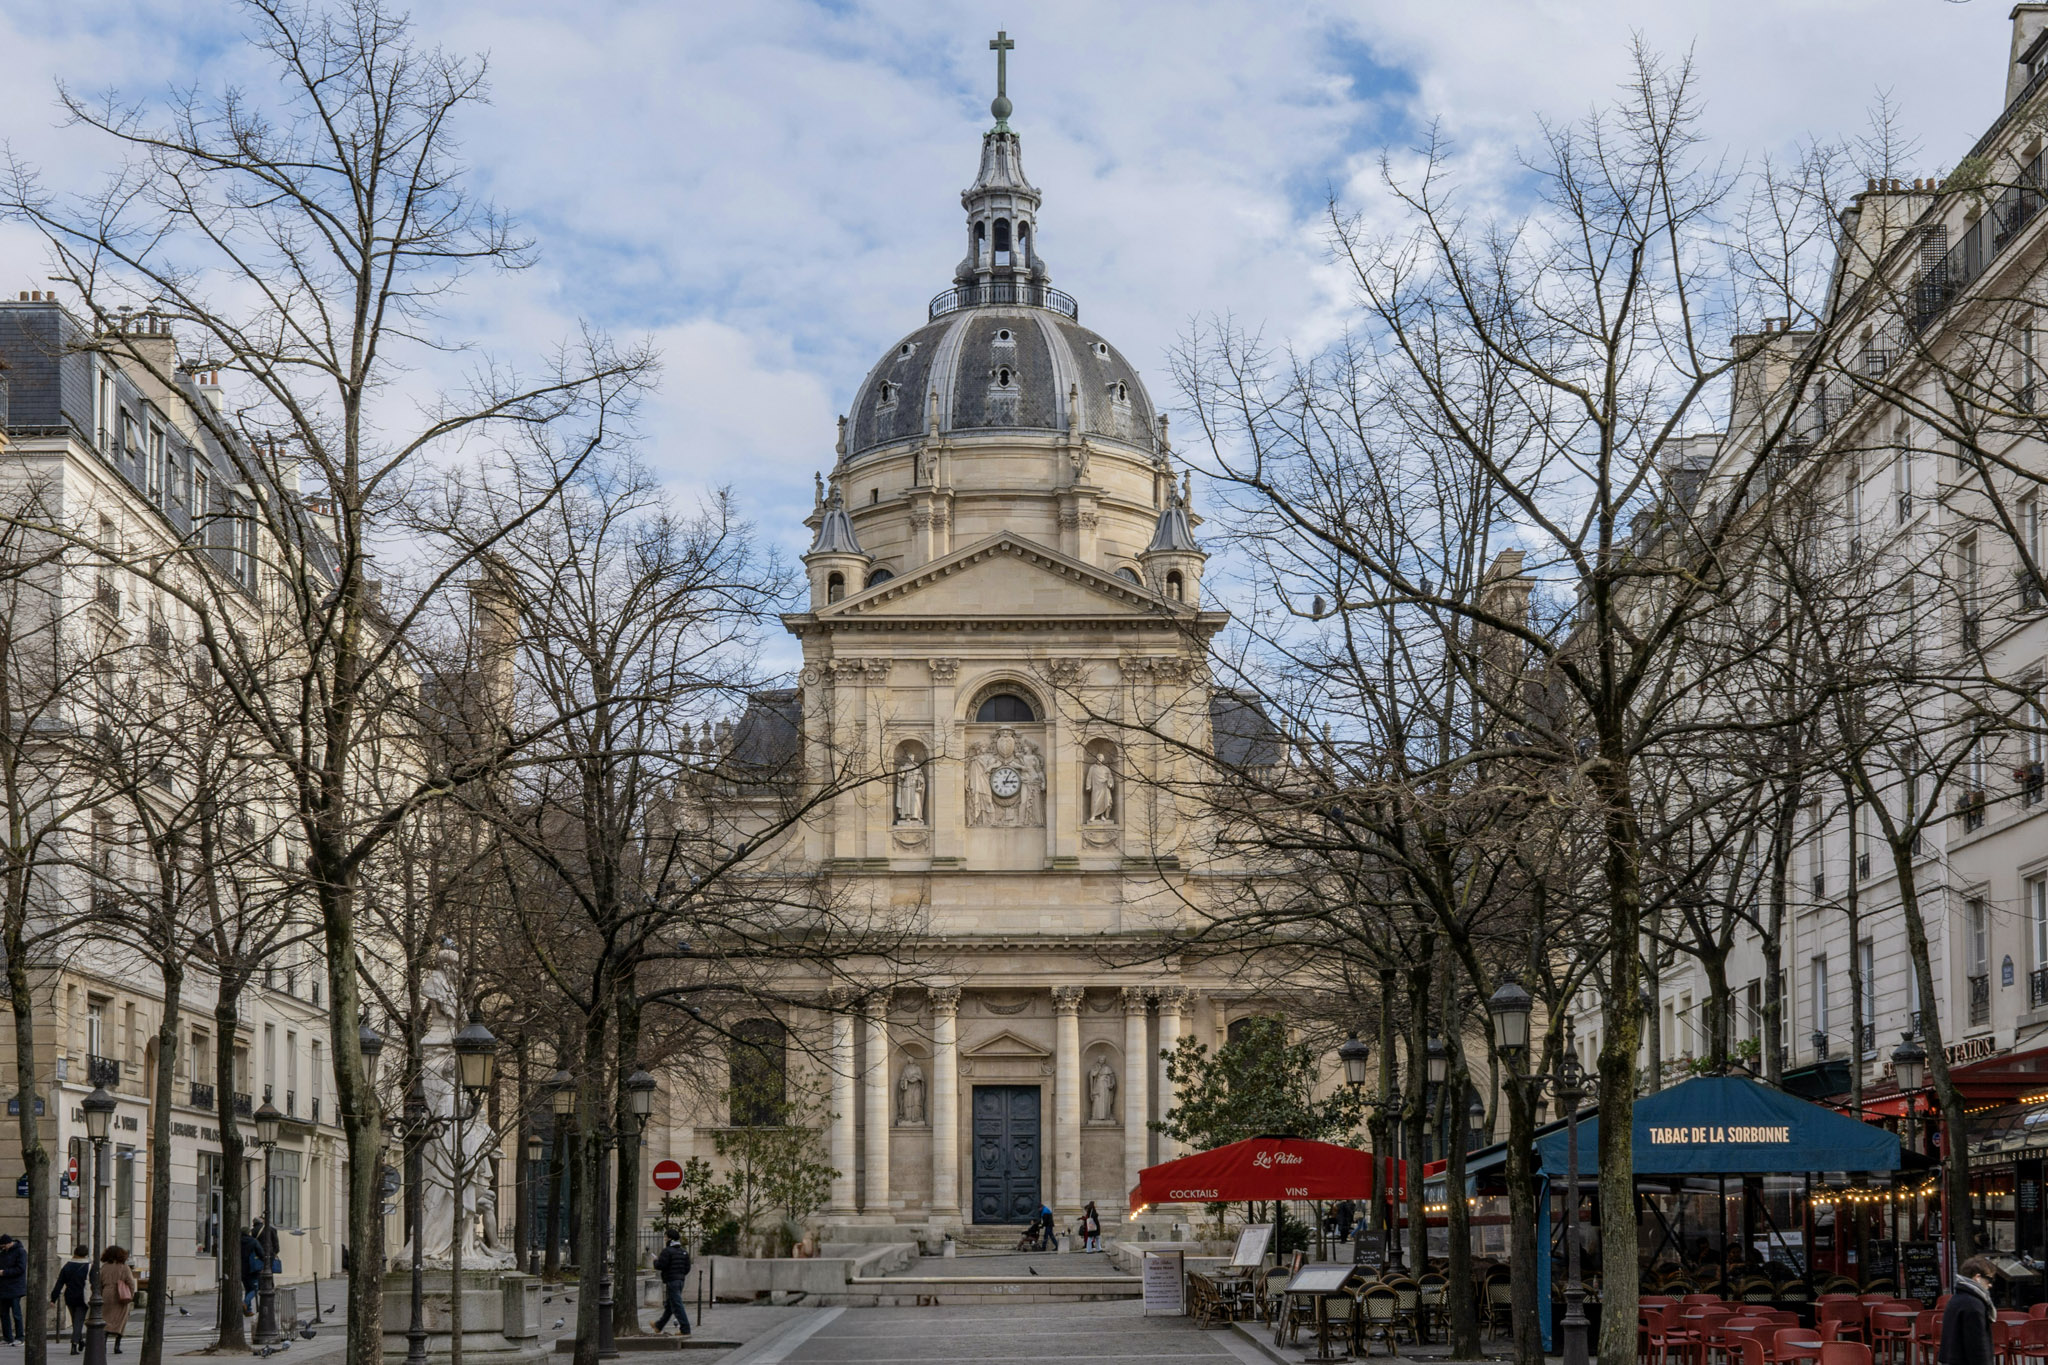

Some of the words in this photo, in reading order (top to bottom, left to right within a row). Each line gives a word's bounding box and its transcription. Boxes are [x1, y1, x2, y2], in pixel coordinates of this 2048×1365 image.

[1954, 1037, 1991, 1062] PATIOS
[170, 1121, 198, 1139] LIBRAIRIE
[1650, 1128, 1688, 1143] TABAC
[1692, 1127, 1706, 1142] DE
[1709, 1127, 1724, 1142] LA
[1728, 1127, 1789, 1142] SORBONNE
[1253, 1151, 1272, 1168] Les
[1274, 1151, 1303, 1164] Patios
[1169, 1188, 1219, 1199] COCKTAILS
[1285, 1187, 1308, 1196] VINS
